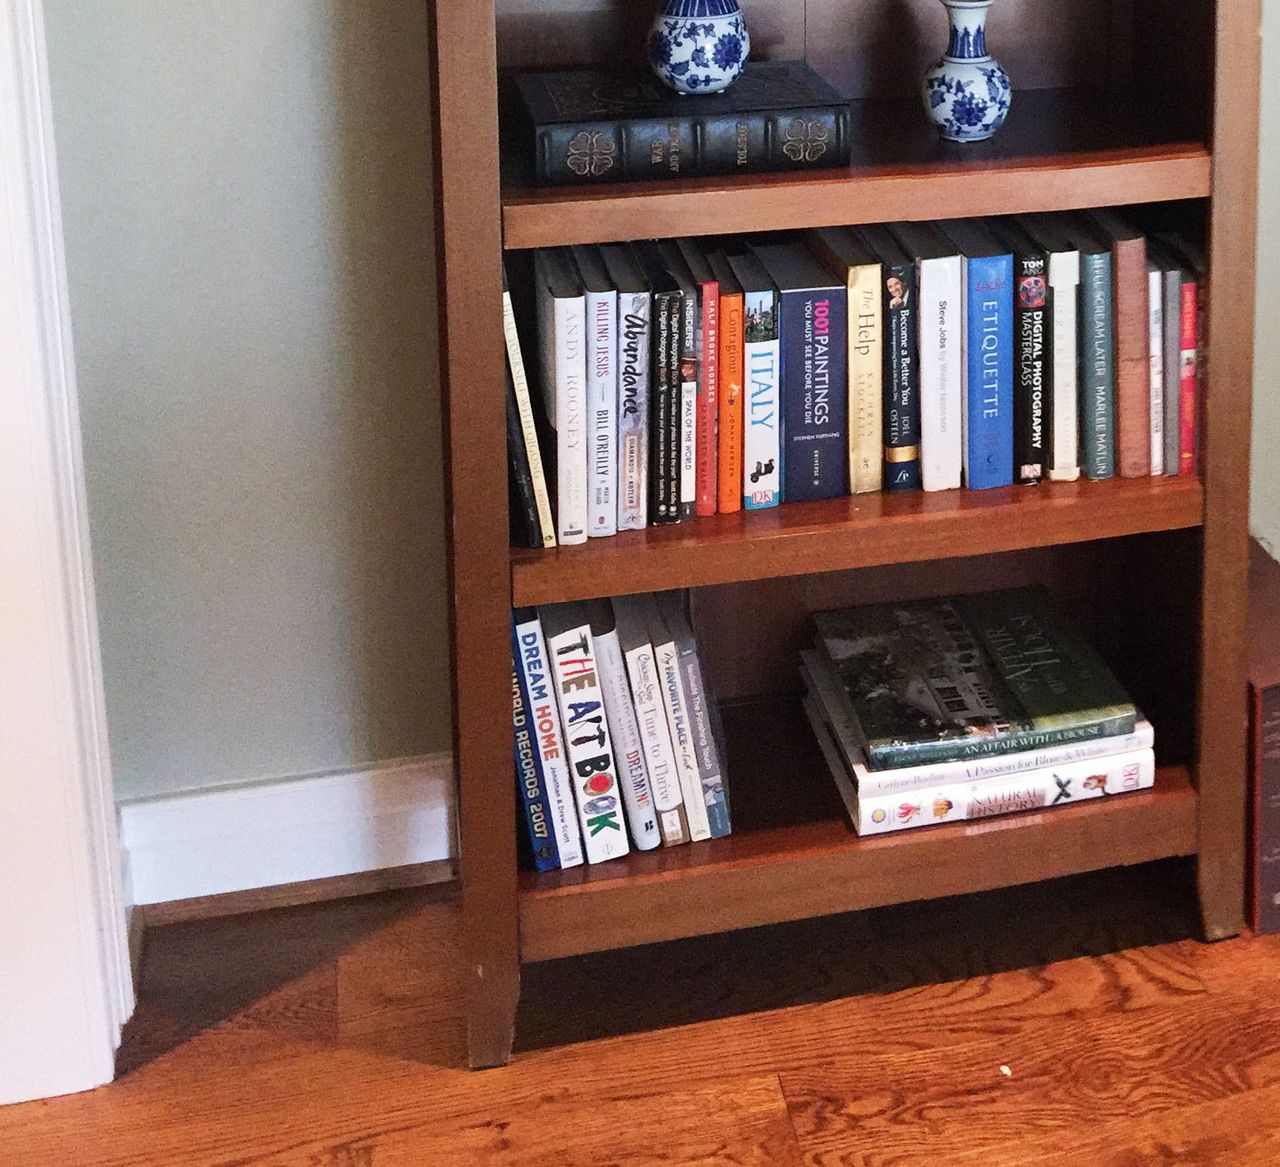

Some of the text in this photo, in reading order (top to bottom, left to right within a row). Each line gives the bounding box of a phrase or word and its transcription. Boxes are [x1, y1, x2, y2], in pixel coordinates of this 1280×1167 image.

[1021, 259, 1044, 269] TOM
[565, 309, 578, 363] ANDY
[595, 301, 609, 378] KILLING JESUS
[659, 310, 668, 330] Digital
[671, 313, 680, 333] Digital
[725, 308, 740, 375] Contagious
[855, 288, 876, 357] The Help
[900, 309, 911, 348] Become
[938, 300, 948, 326] Steve
[938, 327, 948, 350] Jobs
[1093, 289, 1106, 339] SCREAM
[623, 313, 648, 418] Abundance
[659, 330, 668, 368] Photography
[671, 333, 680, 370] Photography
[804, 300, 813, 425] YOU MUST SEE BEFORE YOU DIE
[900, 356, 911, 386] Better
[980, 299, 1000, 420] ETIQUETTE
[1020, 311, 1033, 387] MASTERCLASS
[1093, 340, 1106, 377] LATER
[750, 351, 774, 430] ITALY
[814, 335, 829, 425] PAINTINGS
[901, 386, 911, 406] You
[1031, 310, 1044, 450] DIGITAL PHOTOGRAPHY
[565, 374, 580, 452] ROONEY
[595, 409, 609, 476] BILL O'REILLY
[890, 409, 899, 445] OSTEEN
[901, 415, 911, 436] JOEL
[1094, 385, 1108, 475] MARLEE MATLIN
[524, 430, 542, 480] QIGONG
[685, 445, 693, 471] WORLD
[521, 631, 560, 762] DREAM HOME
[664, 665, 680, 715] FAVORITE
[674, 714, 688, 747] PLACE
[556, 632, 621, 838] THE ART BOOK
[644, 707, 671, 803] Time to Thrive
[692, 695, 713, 771] The Finishing Touch
[964, 743, 979, 754] AN
[1020, 734, 1050, 747] WITH
[515, 728, 540, 799] RECORDS
[529, 802, 548, 839] 2007
[626, 749, 650, 810] DREAMING
[974, 763, 1016, 778] Passion
[1017, 760, 1033, 769] for
[1123, 763, 1140, 789] DK
[550, 766, 561, 798] Jonathan
[557, 805, 565, 824] Drew
[561, 825, 571, 844] Scott
